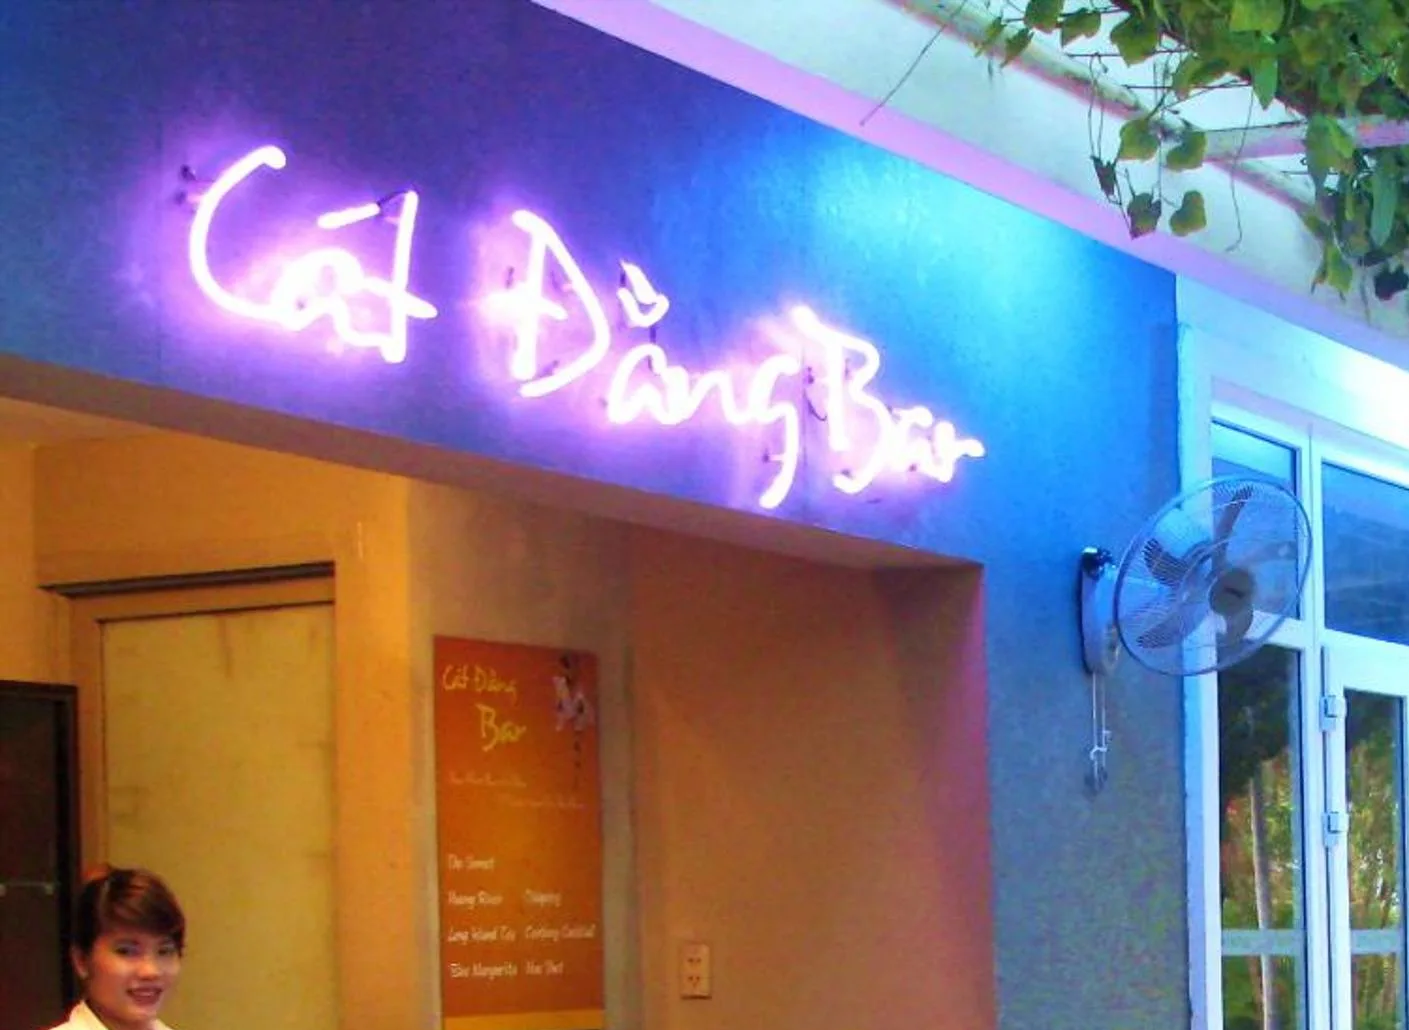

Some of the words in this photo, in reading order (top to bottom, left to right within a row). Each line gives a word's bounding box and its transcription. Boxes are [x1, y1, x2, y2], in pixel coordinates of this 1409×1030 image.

[189, 145, 437, 362] Cát
[788, 305, 985, 492] Bar
[475, 702, 527, 752] Bar
